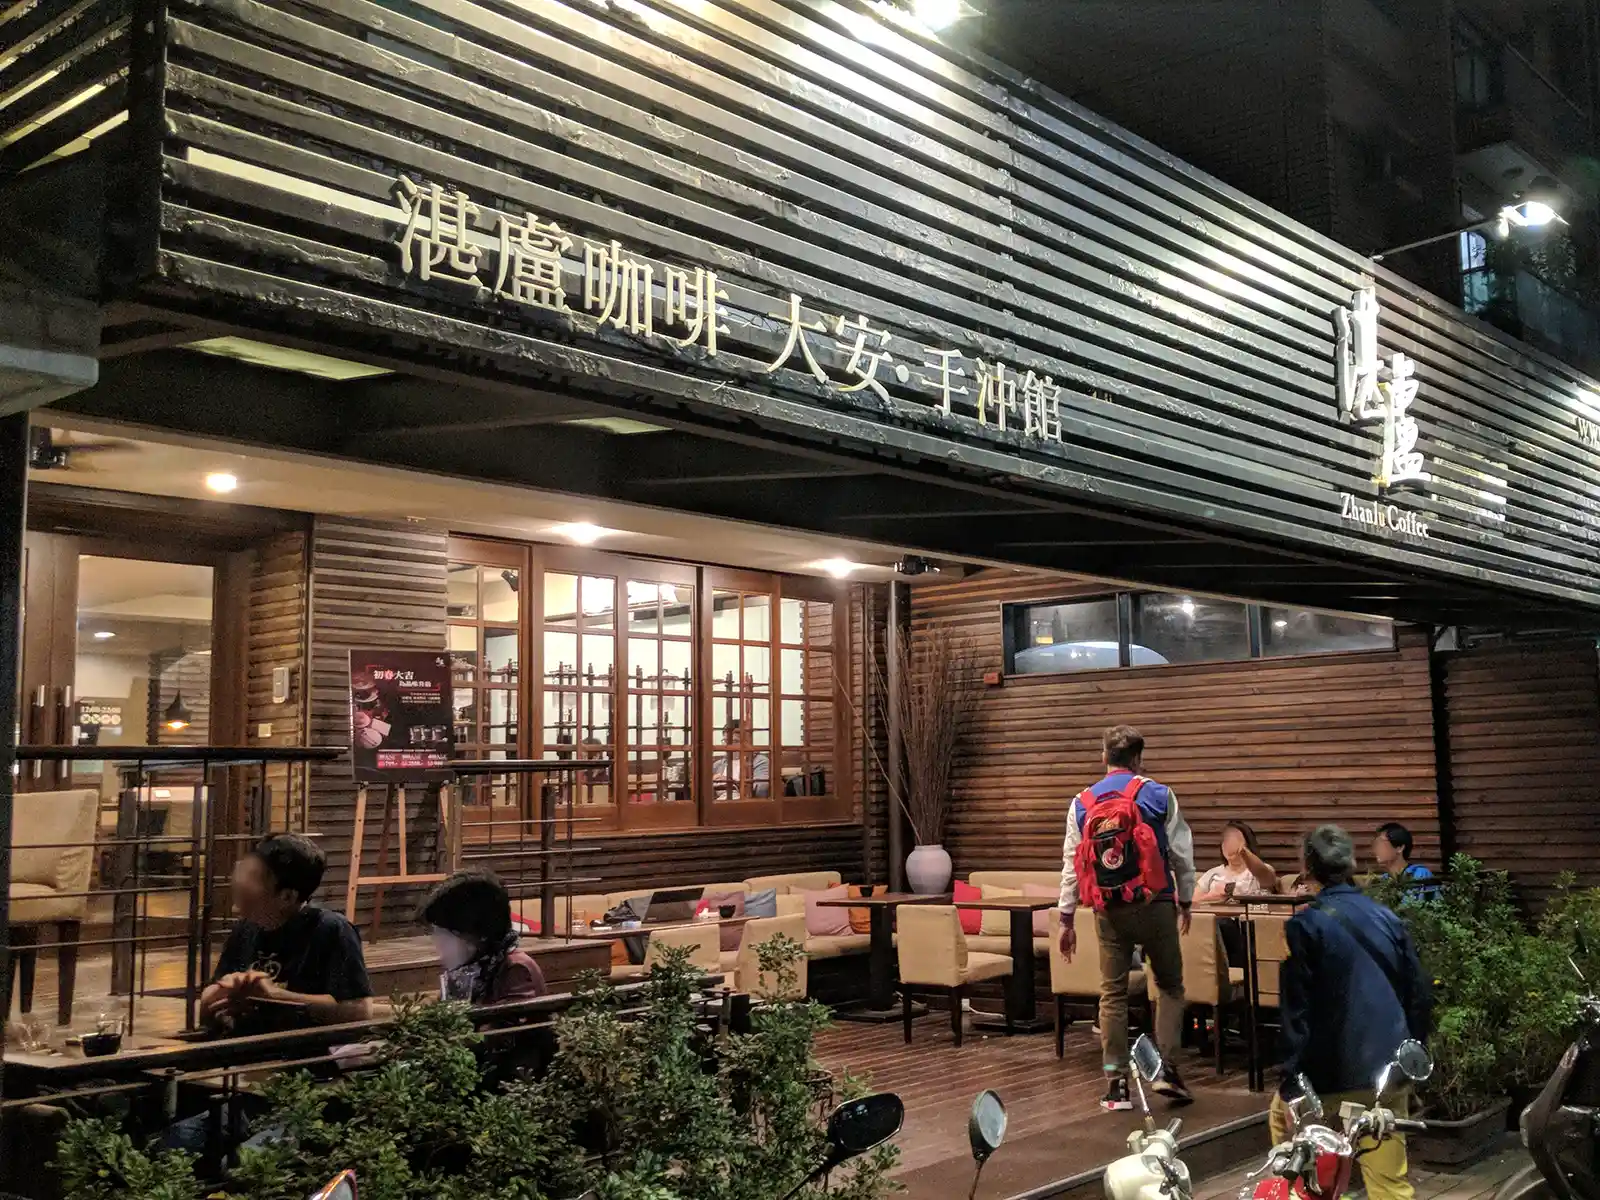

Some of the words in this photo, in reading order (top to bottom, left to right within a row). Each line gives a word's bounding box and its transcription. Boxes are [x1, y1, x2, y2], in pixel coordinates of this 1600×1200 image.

[1340, 492, 1387, 527] Zhanlu
[1387, 504, 1430, 538] Coffee
[373, 669, 415, 681] 初春大吉
